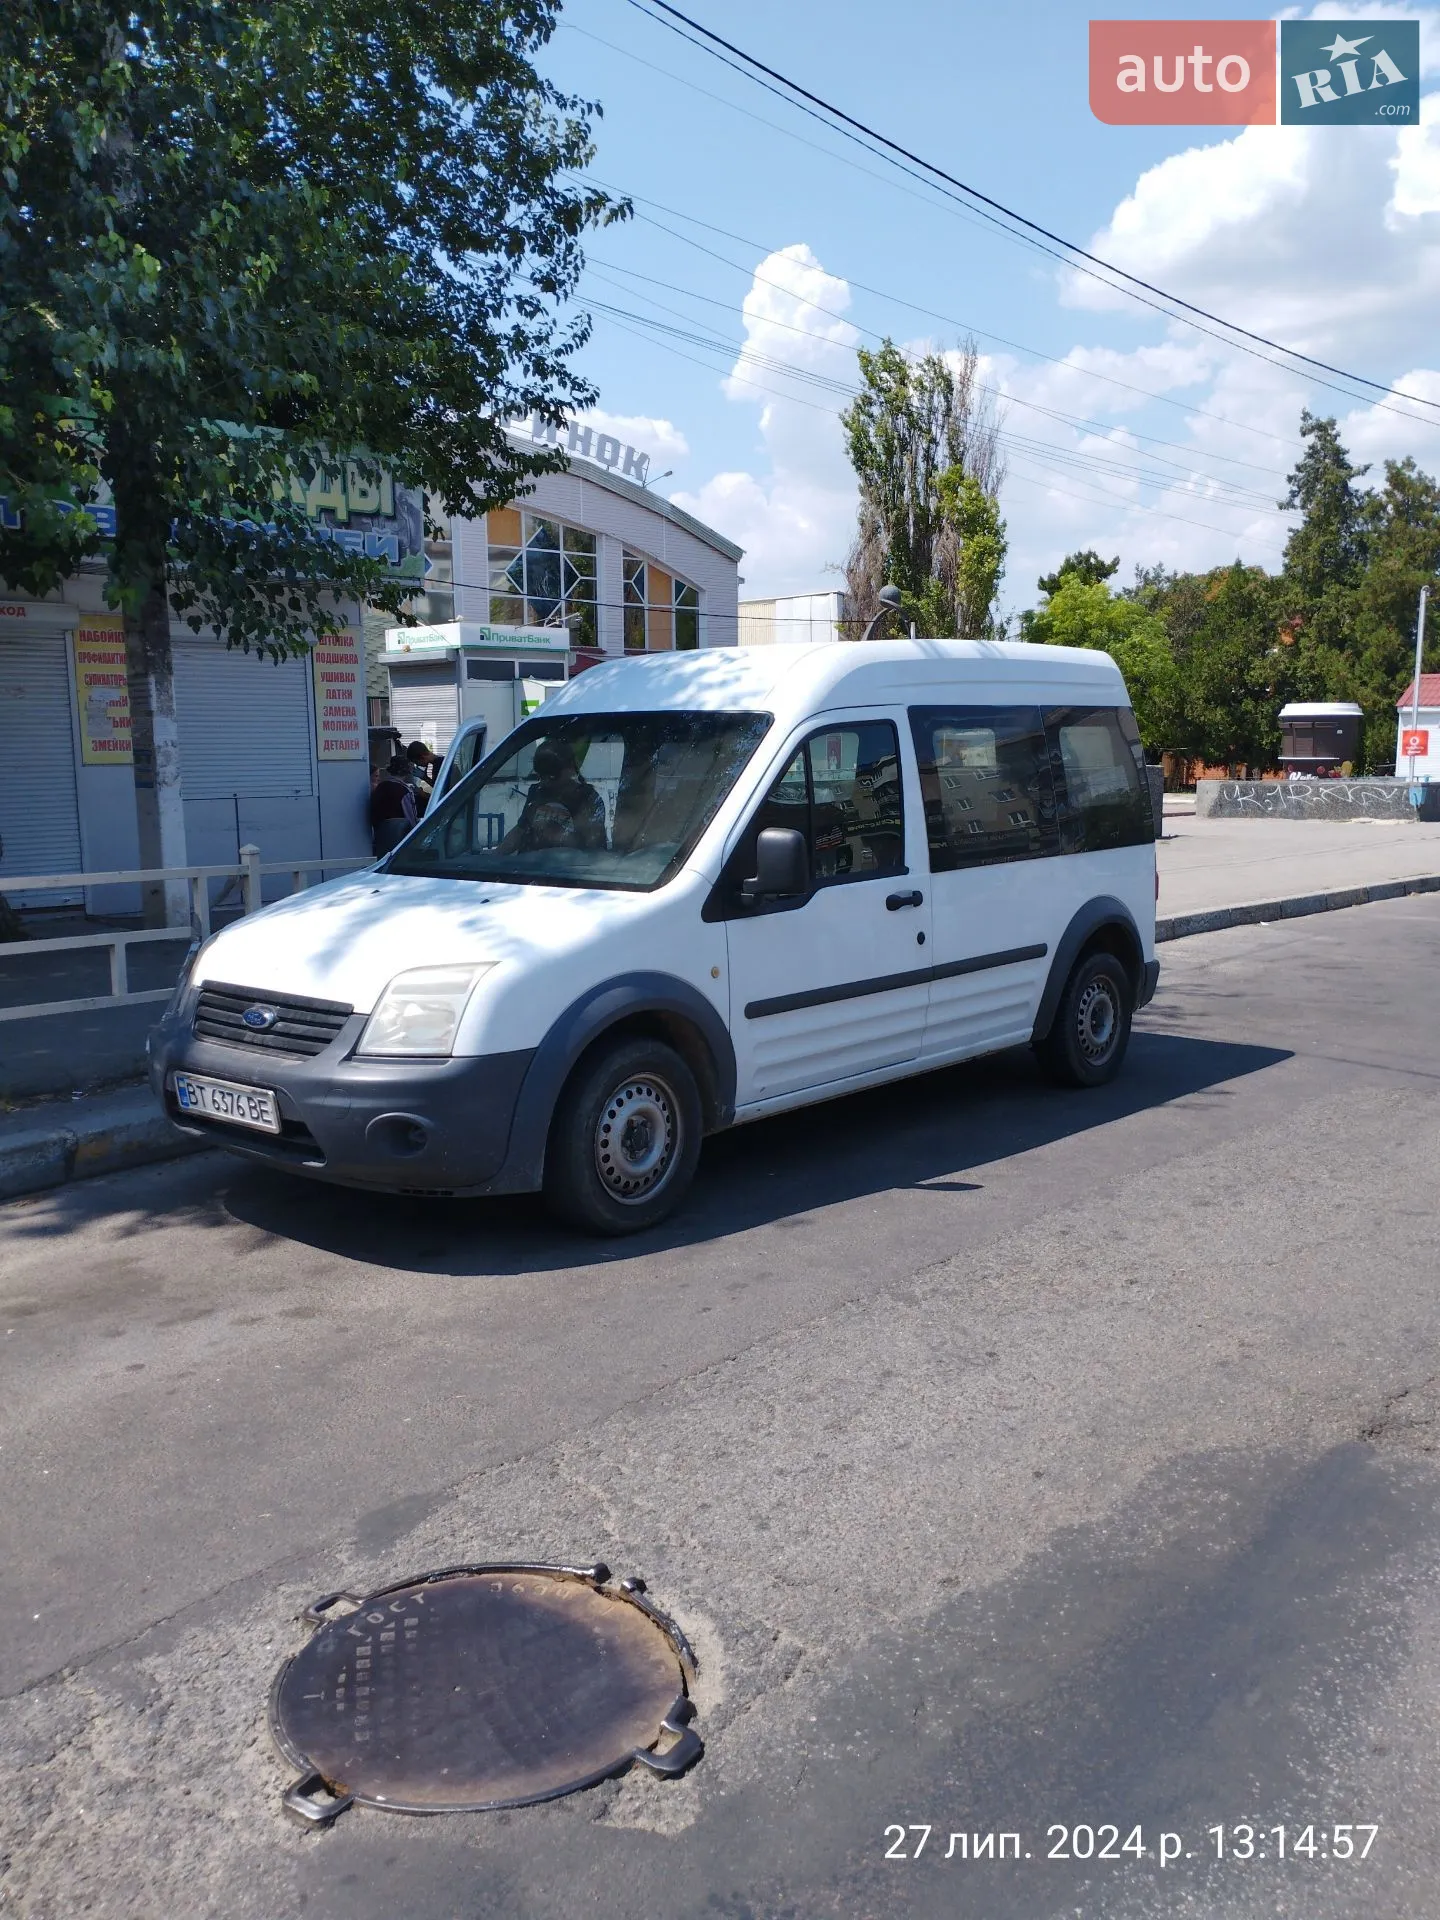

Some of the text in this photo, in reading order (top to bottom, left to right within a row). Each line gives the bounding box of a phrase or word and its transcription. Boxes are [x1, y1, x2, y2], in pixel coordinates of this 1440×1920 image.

[319, 635, 354, 647] ШТОПКА
[491, 632, 552, 645] ПриватБанк
[315, 652, 359, 665] ПОДШИВКА
[320, 671, 356, 683] УШИВКА
[325, 689, 353, 700] ЛАТКИ
[323, 706, 357, 717] ЗАМЕНА
[323, 719, 358, 731] МОЛНИЙ
[91, 738, 132, 752] ЗМЕЙКИ
[323, 739, 360, 752] ДЕТАЛЕЙ
[186, 1082, 272, 1124] BT 6376 BE
